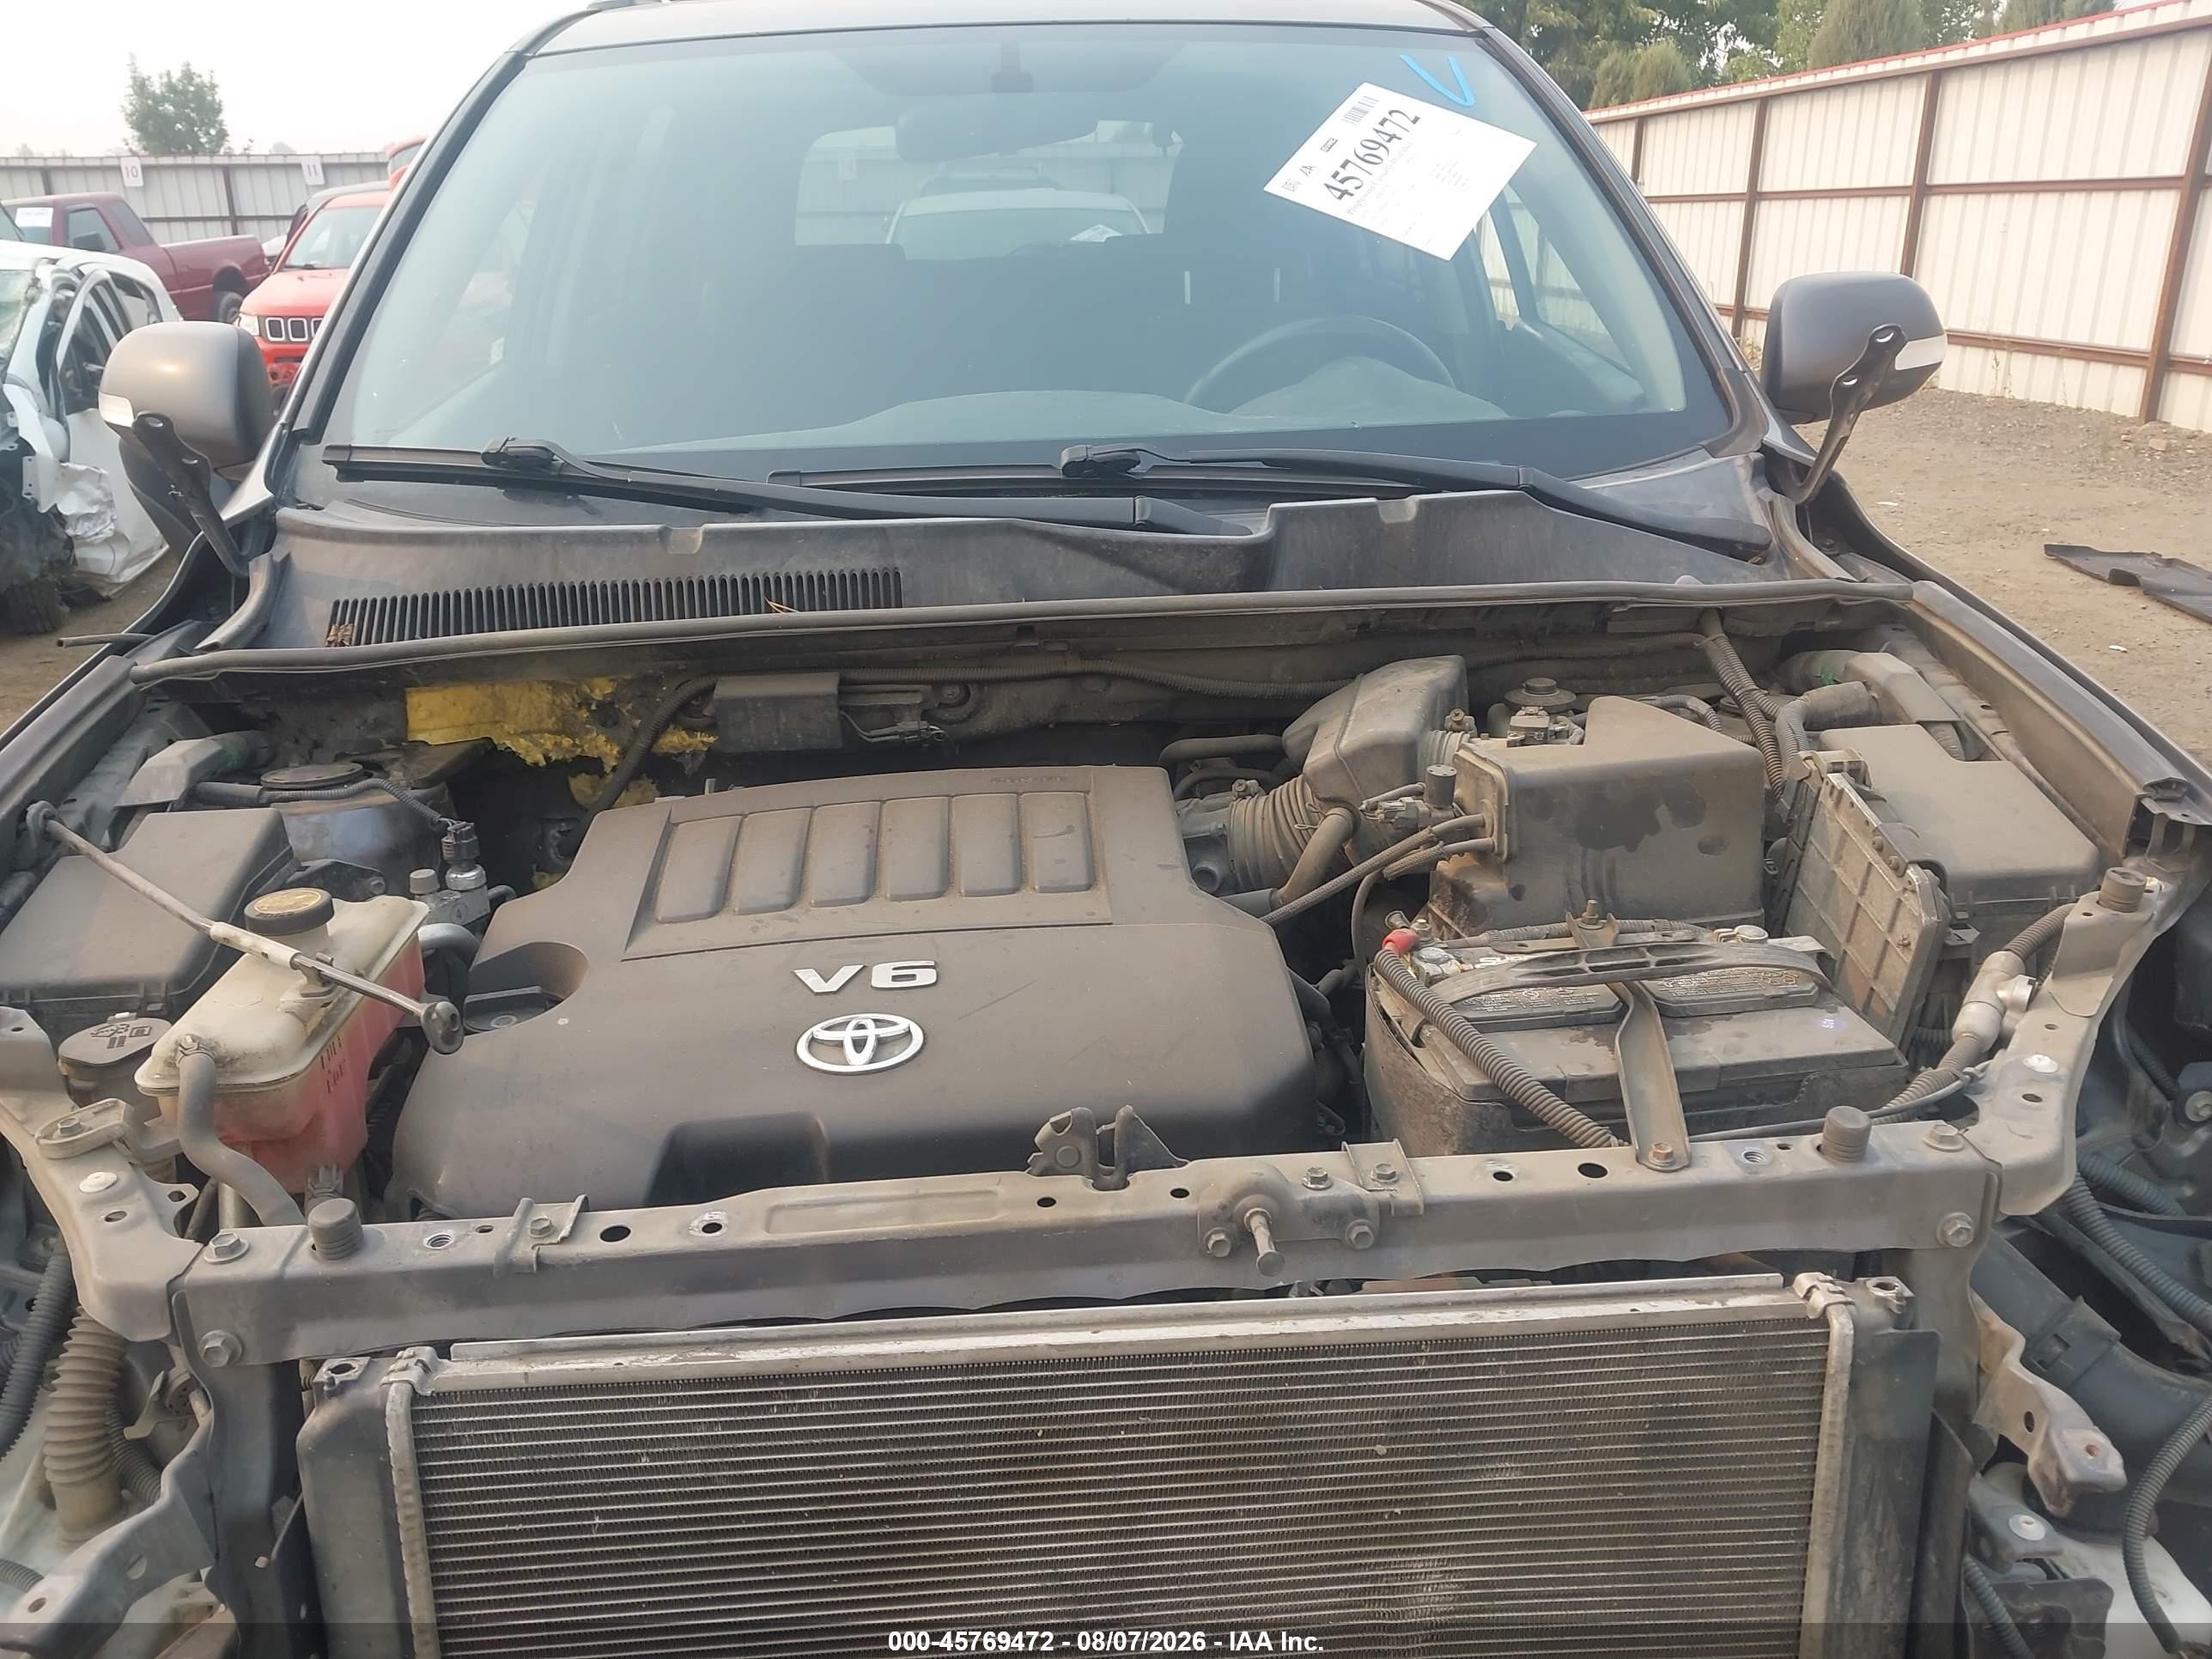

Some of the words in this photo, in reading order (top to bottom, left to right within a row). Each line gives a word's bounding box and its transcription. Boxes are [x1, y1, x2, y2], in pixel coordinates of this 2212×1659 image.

[1323, 109, 1421, 201] 45769472
[124, 166, 138, 179] 10
[791, 960, 938, 994] V6
